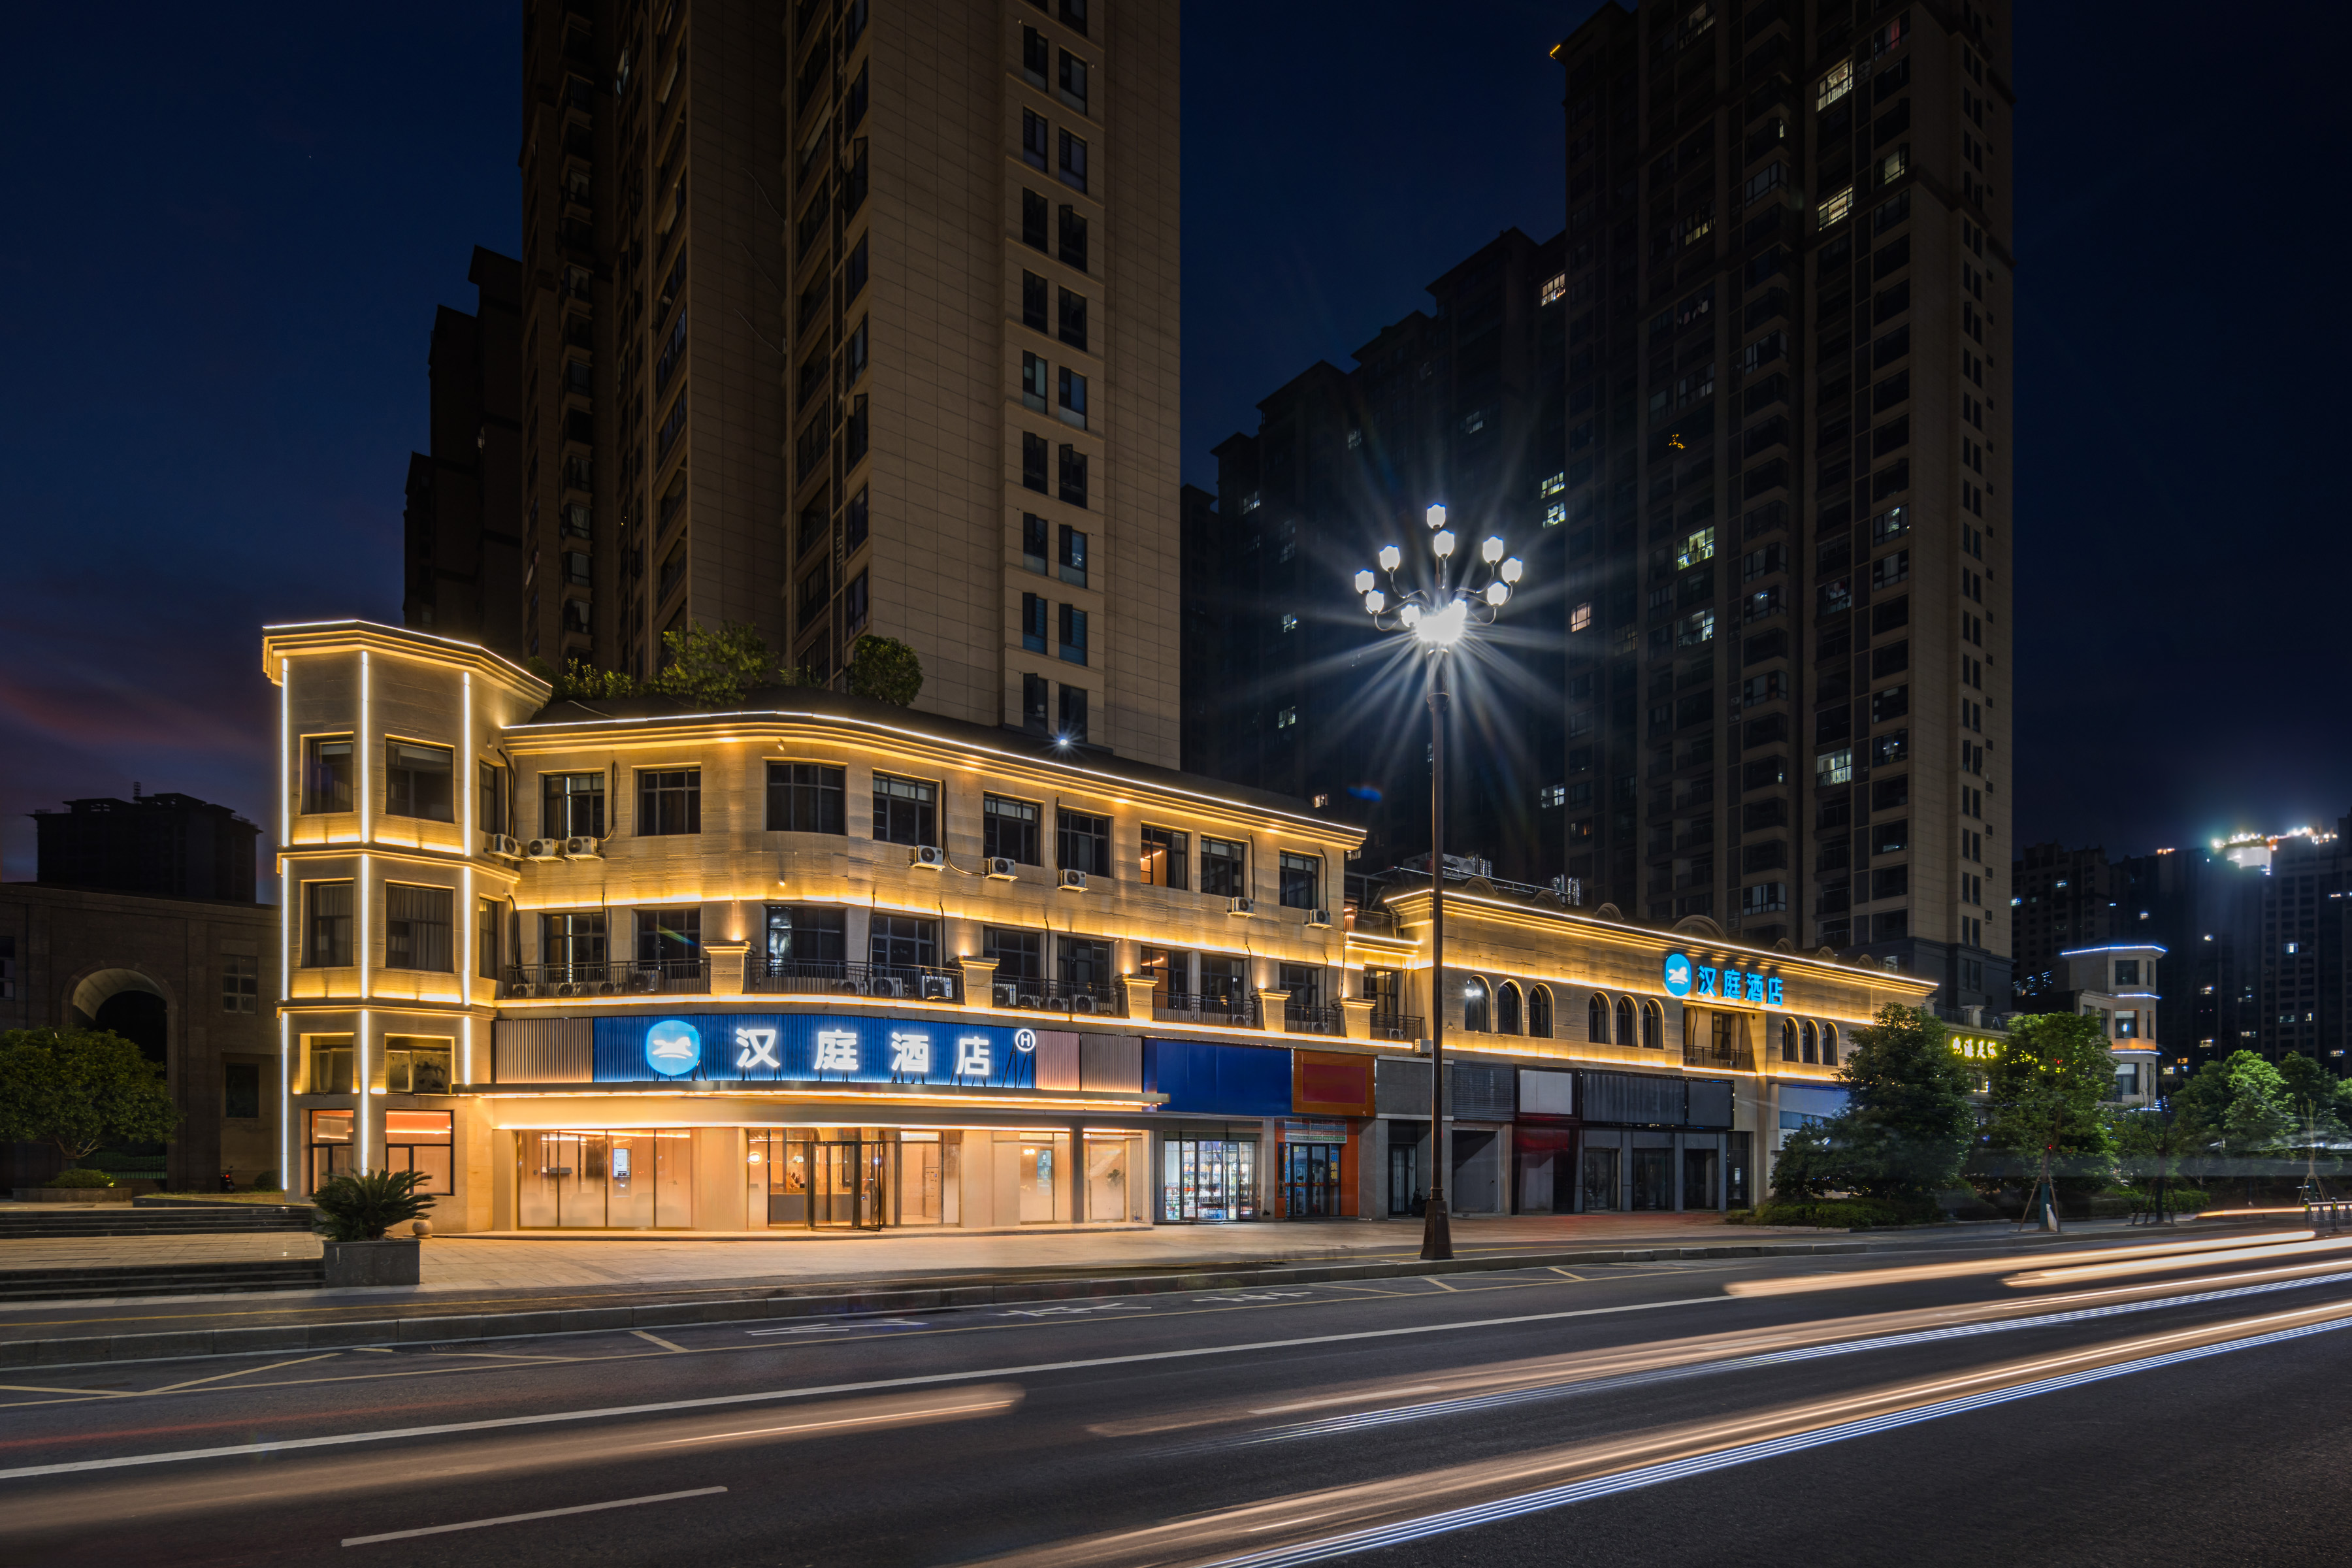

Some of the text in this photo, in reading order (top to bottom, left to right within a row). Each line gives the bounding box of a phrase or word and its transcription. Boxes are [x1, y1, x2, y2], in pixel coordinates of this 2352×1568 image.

[1697, 965, 1784, 1005] 汉庭酒店
[736, 1028, 990, 1076] 汉庭酒店
